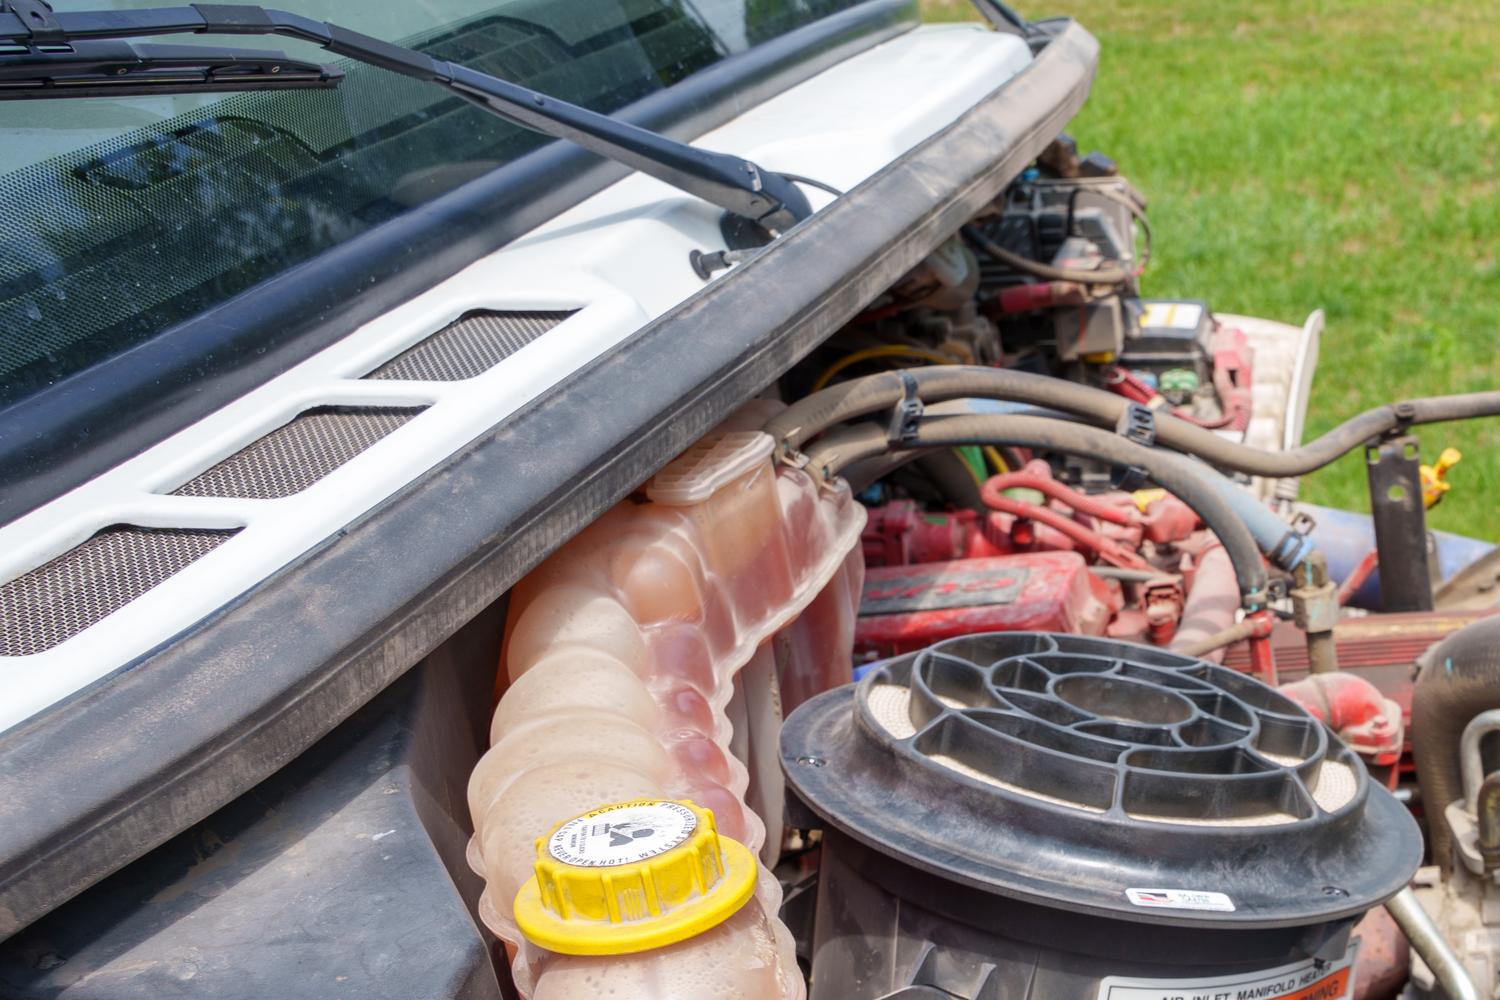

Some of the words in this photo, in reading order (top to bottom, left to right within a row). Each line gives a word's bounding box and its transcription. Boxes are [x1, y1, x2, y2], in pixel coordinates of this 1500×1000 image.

[639, 835, 686, 859] SYSTEM
[568, 857, 597, 866] OPEN
[599, 856, 629, 866] HOT!
